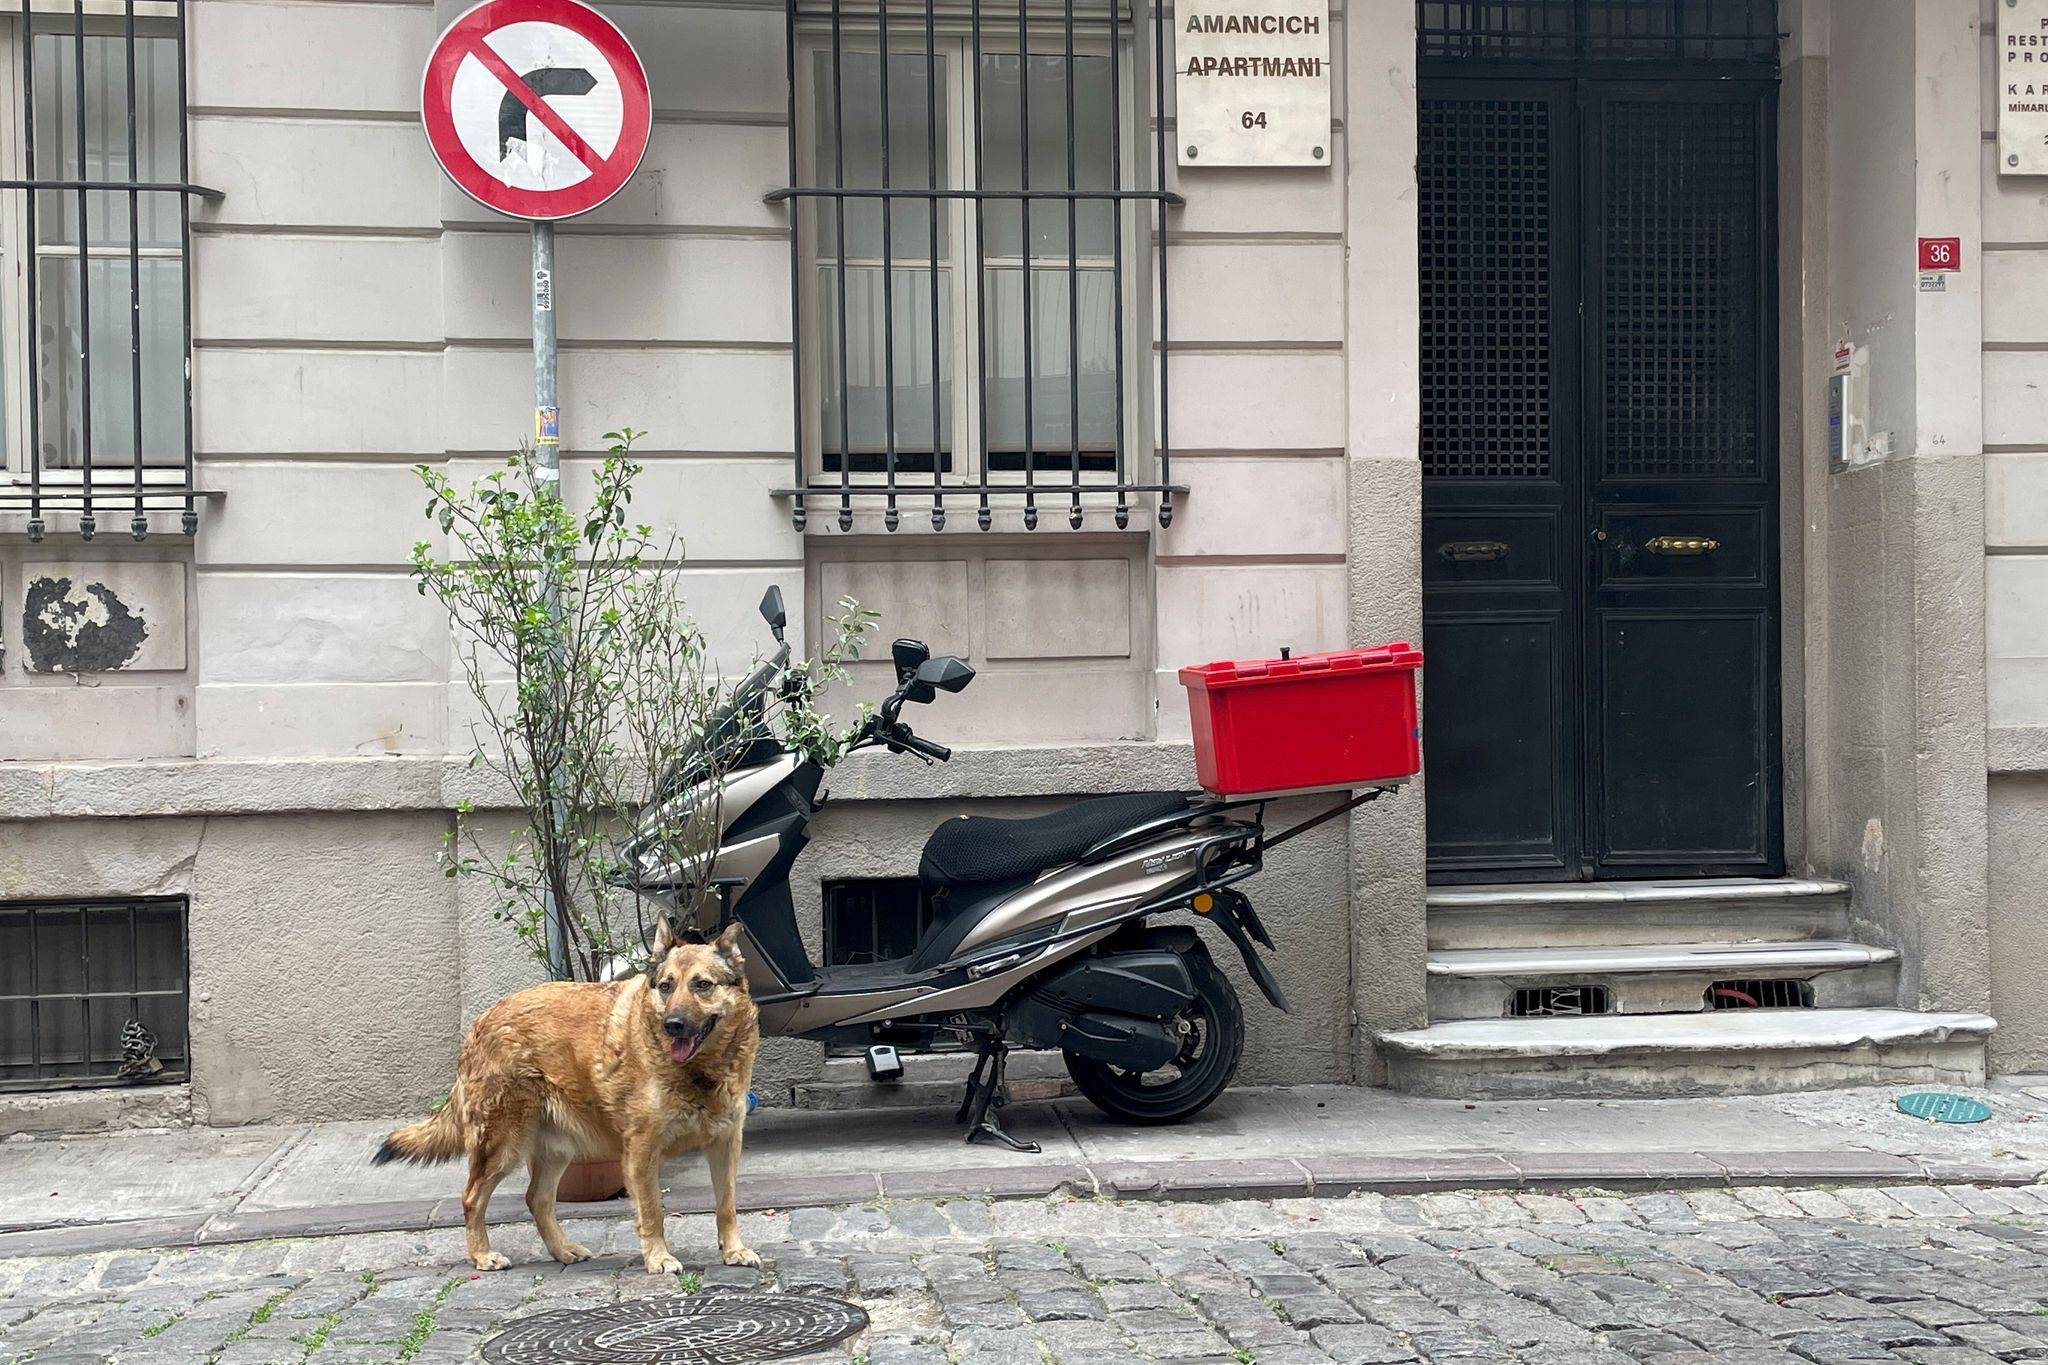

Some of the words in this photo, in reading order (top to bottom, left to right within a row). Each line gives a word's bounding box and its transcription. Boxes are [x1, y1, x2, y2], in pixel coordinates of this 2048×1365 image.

[1186, 15, 1320, 34] AMANCICH
[2008, 35, 2048, 46] REST
[1187, 56, 1321, 77] APARTMANI
[1241, 111, 1267, 129] 64
[1930, 244, 1950, 262] 36
